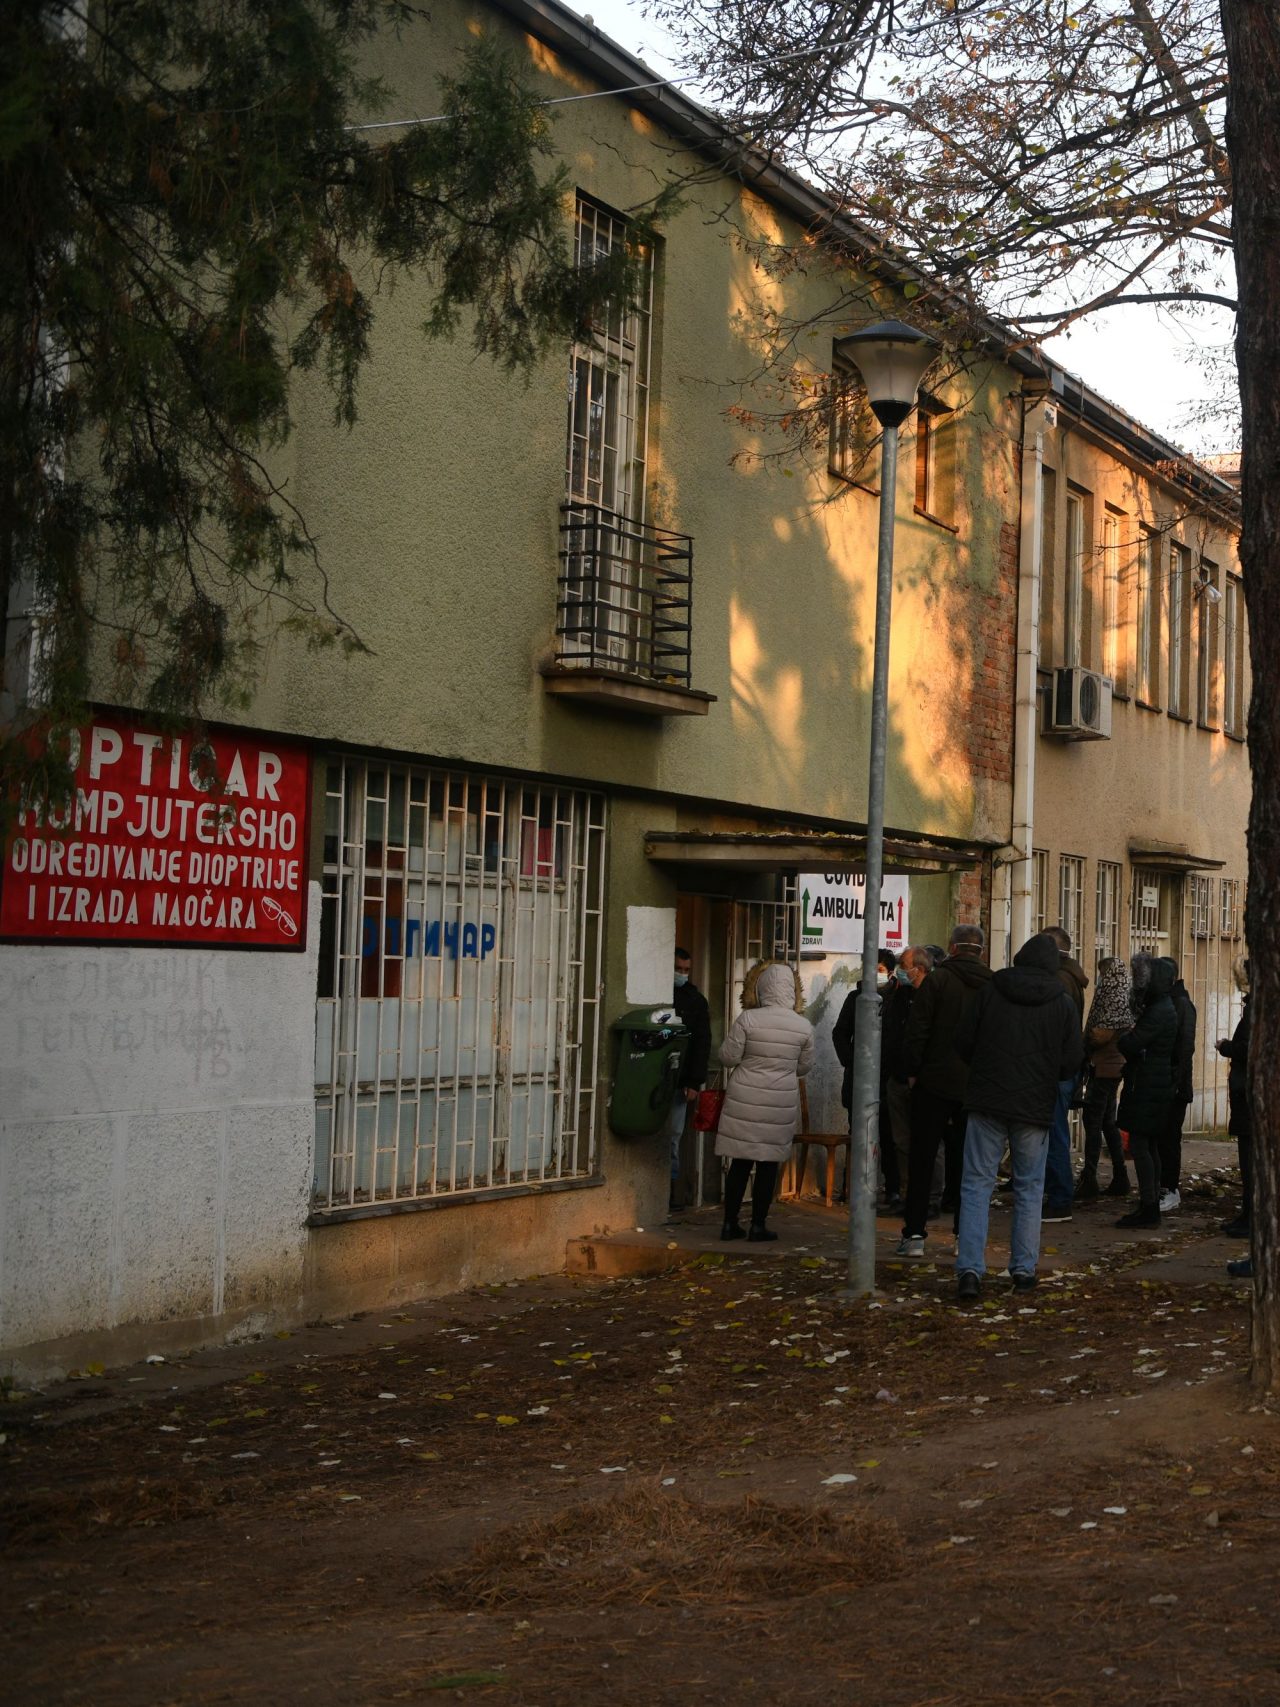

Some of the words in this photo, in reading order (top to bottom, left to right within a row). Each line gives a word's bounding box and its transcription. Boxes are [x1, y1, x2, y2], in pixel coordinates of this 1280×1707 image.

[12, 838, 181, 884] ODREĐIVANJE
[188, 852, 299, 891] DIOPTRIJE
[28, 885, 36, 920] I
[48, 886, 139, 925] IZRADA
[152, 889, 257, 930] NAOČARA
[812, 896, 895, 921] AMBULTA
